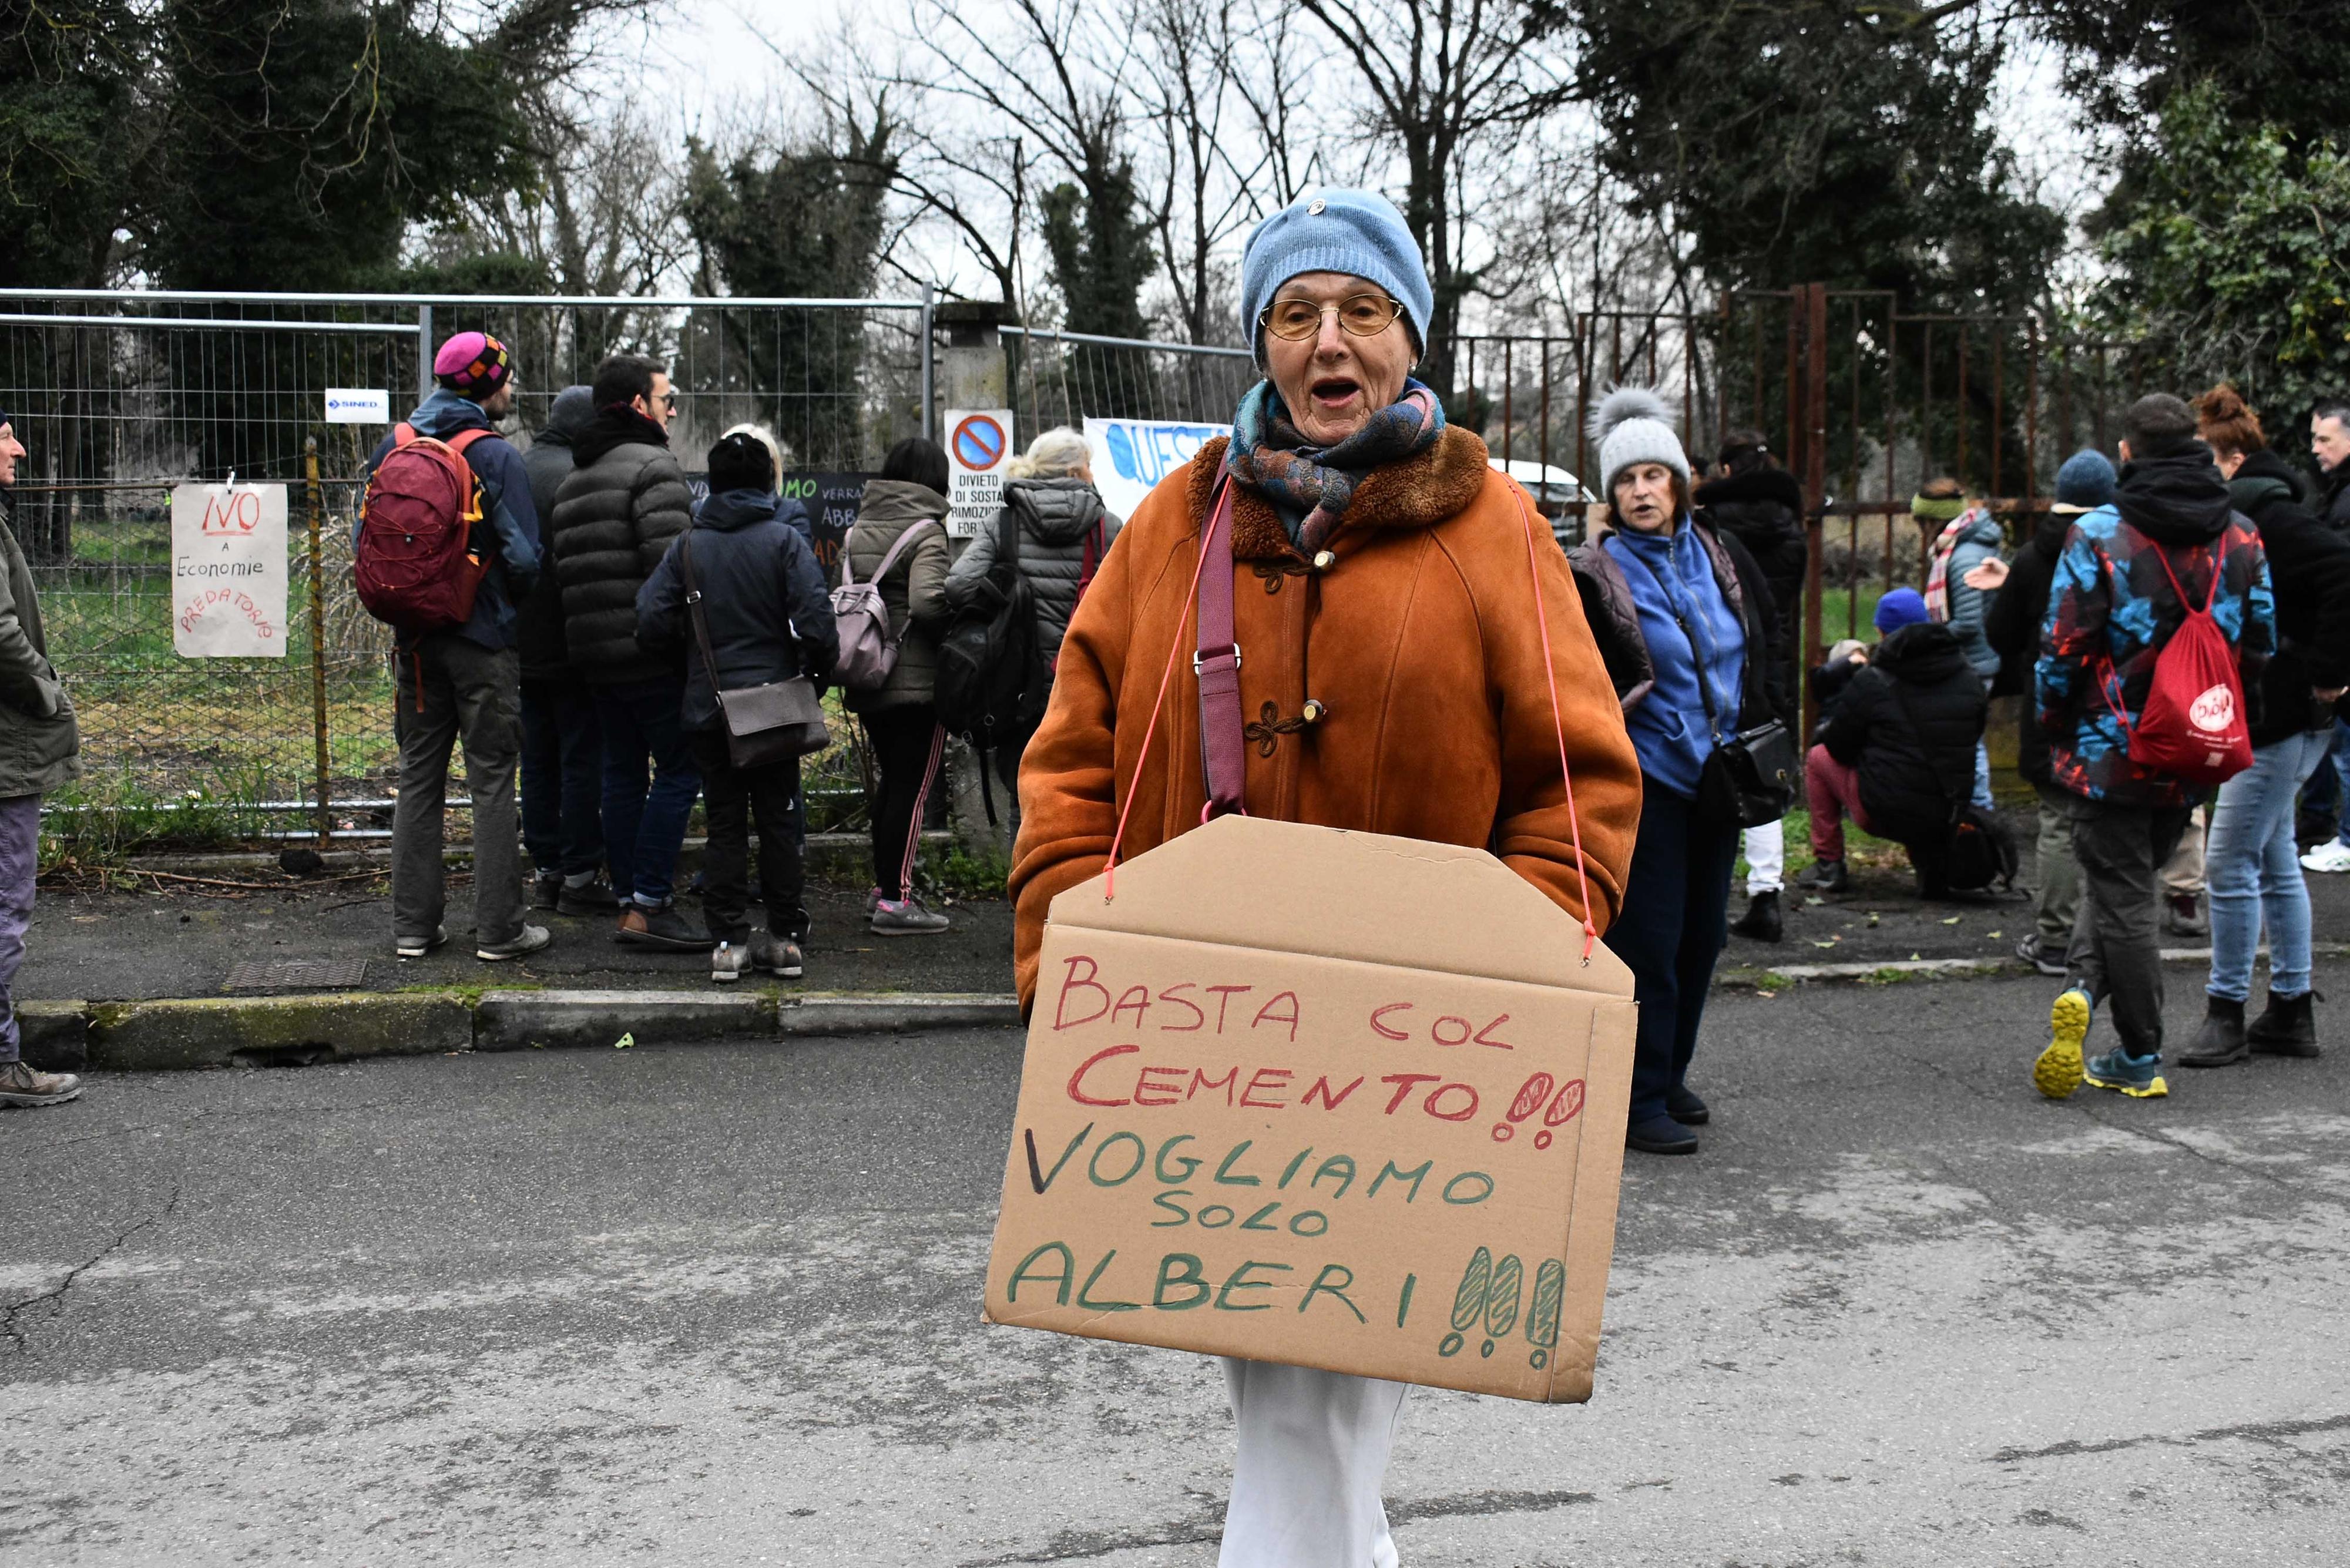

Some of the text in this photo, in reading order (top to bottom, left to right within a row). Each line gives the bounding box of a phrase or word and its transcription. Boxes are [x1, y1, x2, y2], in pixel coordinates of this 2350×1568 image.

[1106, 424, 1223, 488] QUEST
[959, 475, 998, 486] DIVIETO
[955, 491, 1003, 503] DI SOSTA
[202, 492, 260, 530] NO
[822, 506, 855, 528] ABB
[958, 522, 980, 535] FOR
[221, 542, 229, 552] A
[177, 556, 264, 577] Economie
[1054, 955, 1514, 1050] BASTA COL
[1025, 1122, 1494, 1204] VOGLIAMO
[1152, 1190, 1328, 1237] SOLO
